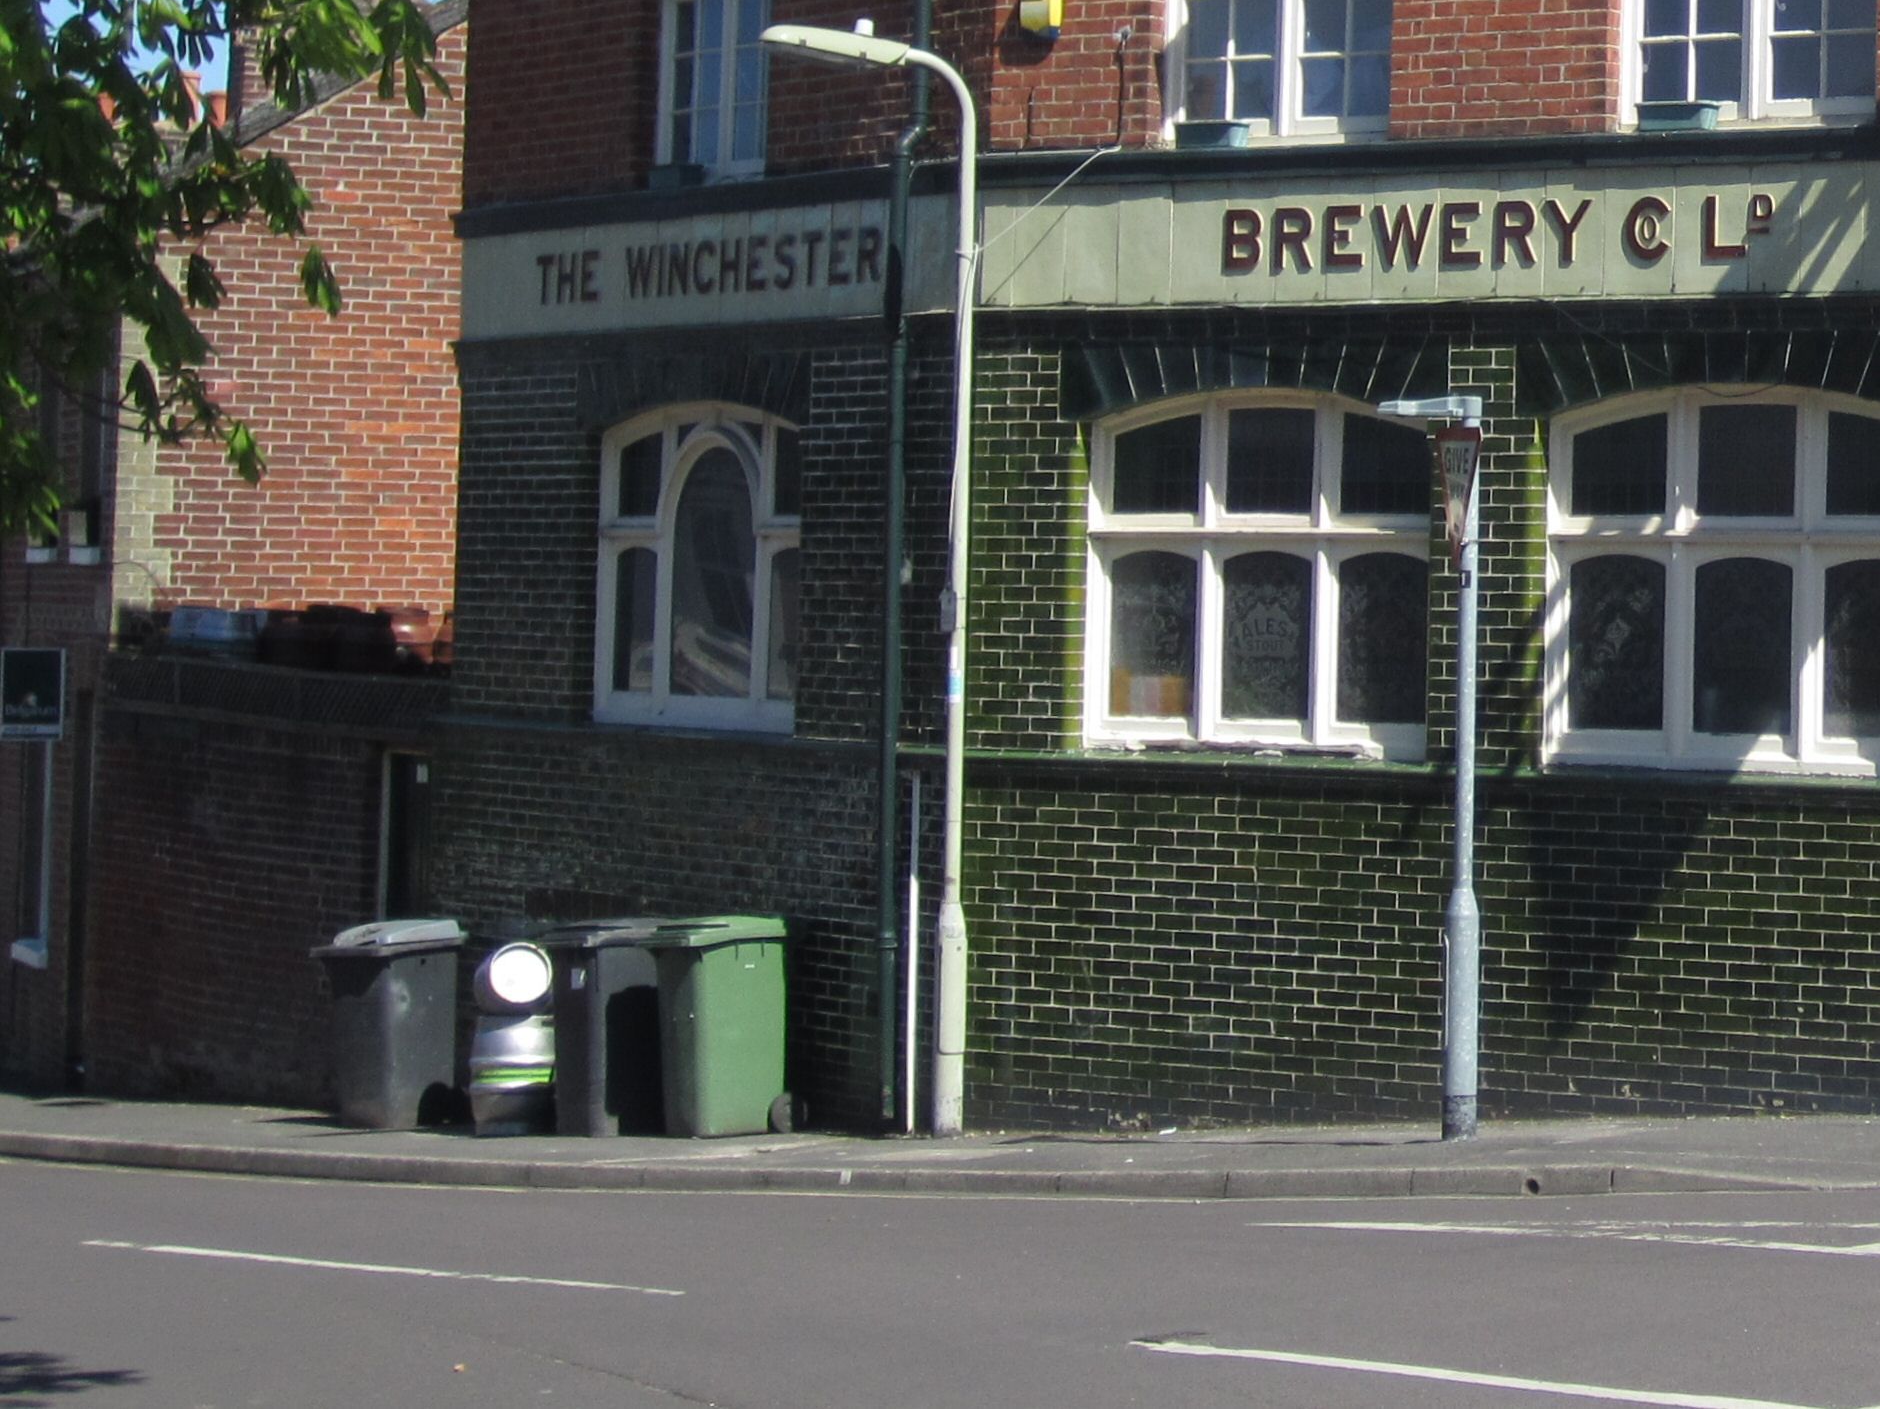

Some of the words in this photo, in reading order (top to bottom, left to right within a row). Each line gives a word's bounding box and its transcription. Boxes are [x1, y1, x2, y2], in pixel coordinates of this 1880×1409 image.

[1222, 198, 1597, 276] BREWERY
[536, 250, 599, 306] THE
[625, 226, 882, 300] WINCHESTER
[1444, 446, 1470, 475] GIVE
[1242, 617, 1288, 638] ALES
